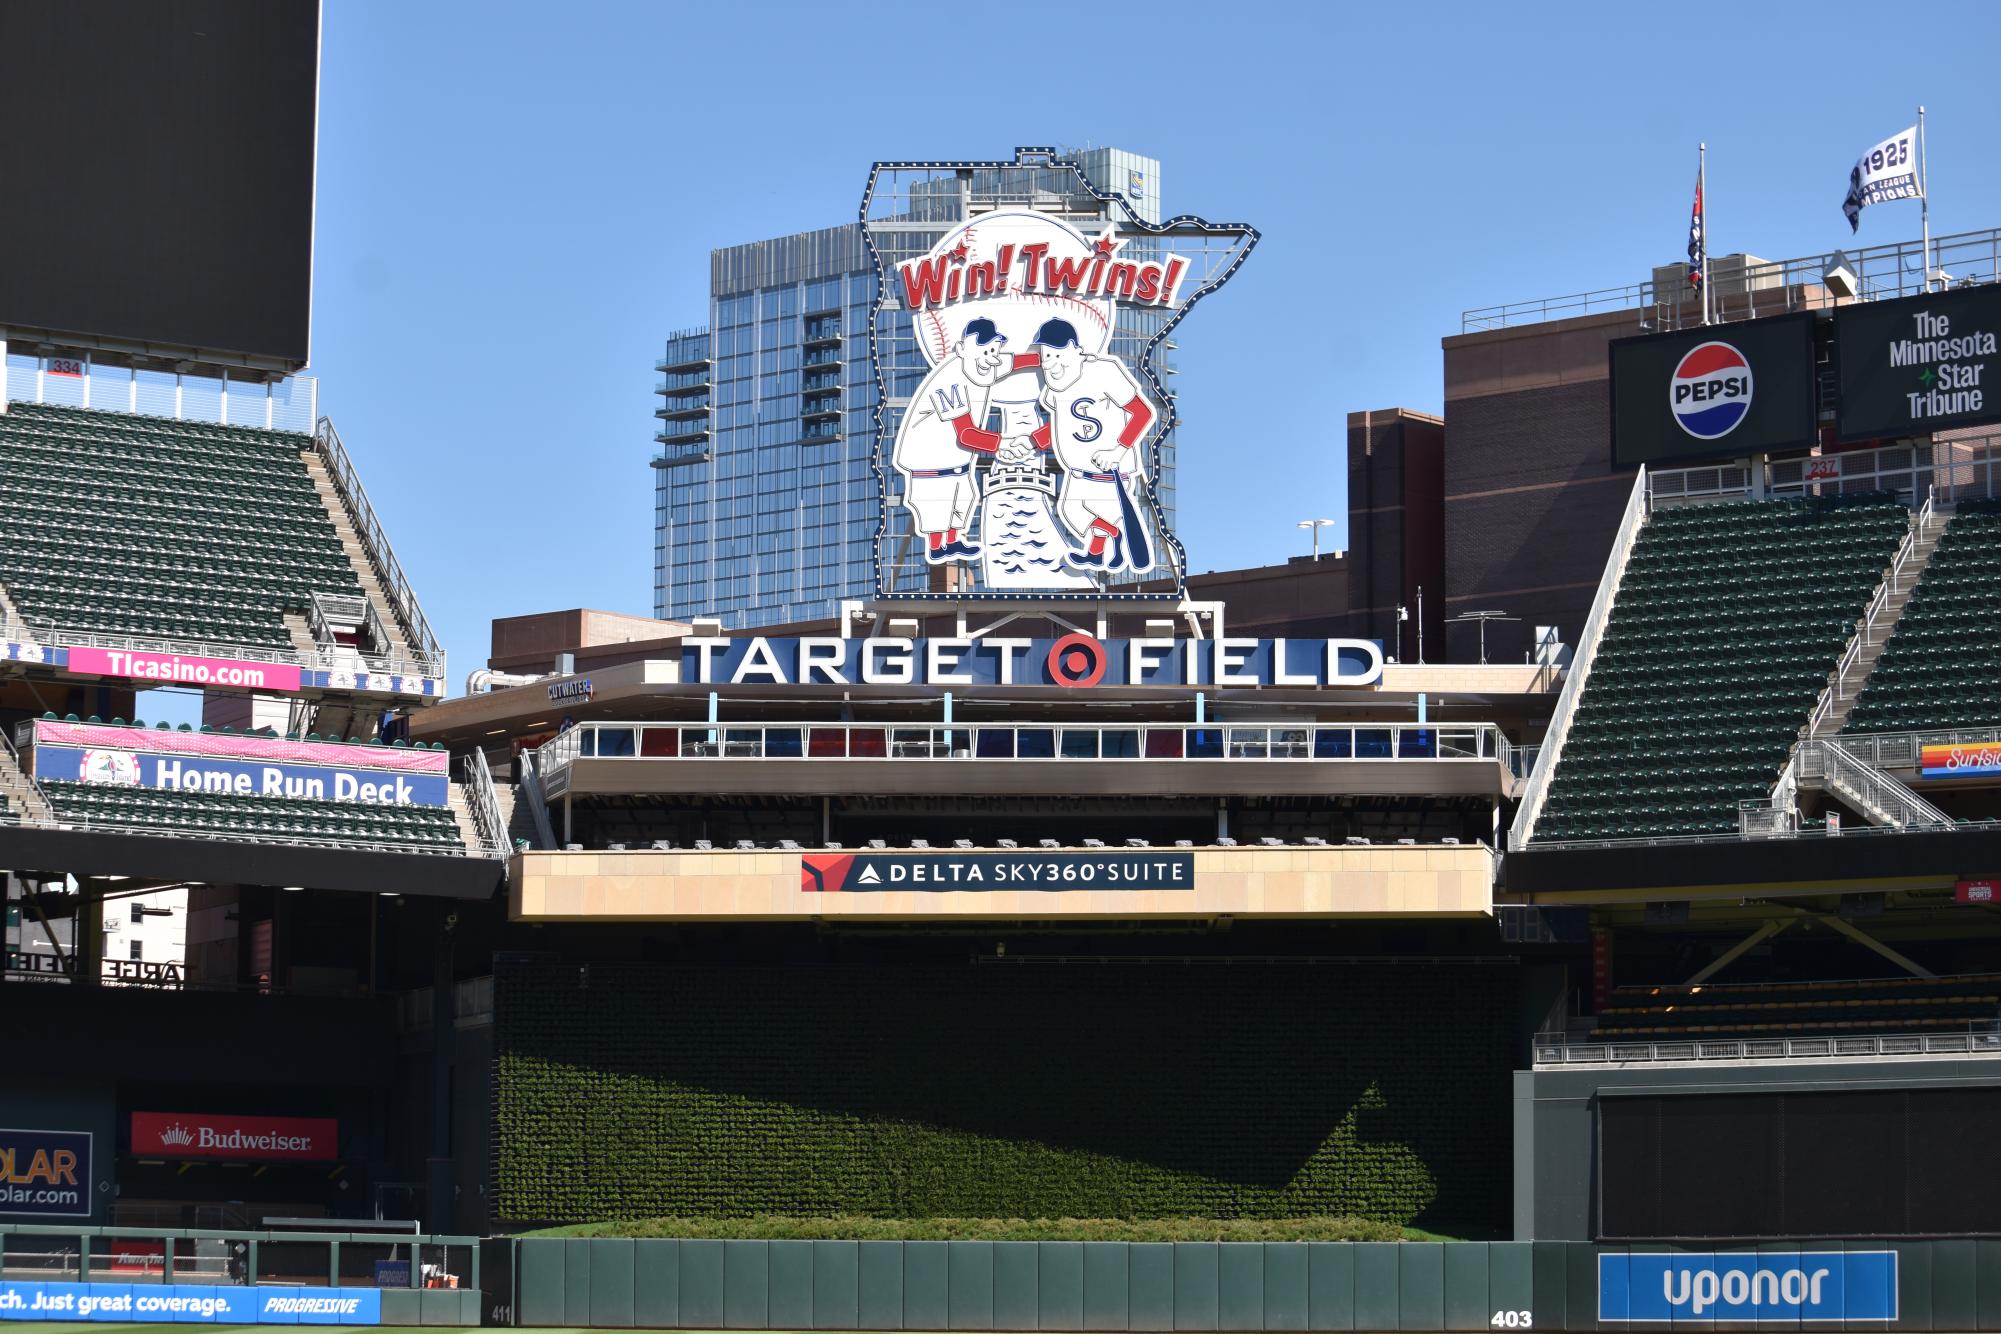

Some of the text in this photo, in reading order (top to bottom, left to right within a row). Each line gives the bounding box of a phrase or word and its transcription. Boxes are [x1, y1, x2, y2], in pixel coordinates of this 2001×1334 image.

[1862, 138, 1909, 175] 1925
[1879, 175, 1911, 189] LEAGUE
[1861, 184, 1916, 207] MPIONS
[901, 233, 1183, 310] Win! Twins!
[1912, 310, 1950, 339] The
[1889, 330, 1997, 368] Minnesota
[54, 360, 80, 374] 334
[1937, 363, 1984, 390] Star
[1675, 375, 1749, 405] PEPSI
[1906, 388, 1983, 419] Tribune
[1810, 459, 1837, 476] 237
[682, 636, 1384, 686] TARGET FIELD
[157, 759, 414, 805] Home Run Deck
[890, 863, 985, 882] DELTA
[198, 1127, 312, 1152] Budweiser
[31, 1291, 73, 1311] Just
[78, 1294, 132, 1315] great
[136, 1296, 231, 1316] coverage.
[1663, 1268, 1829, 1314] uponor
[264, 1297, 359, 1314] PROGRESSIVE
[492, 1305, 511, 1323] 411
[1491, 1310, 1532, 1328] 403
